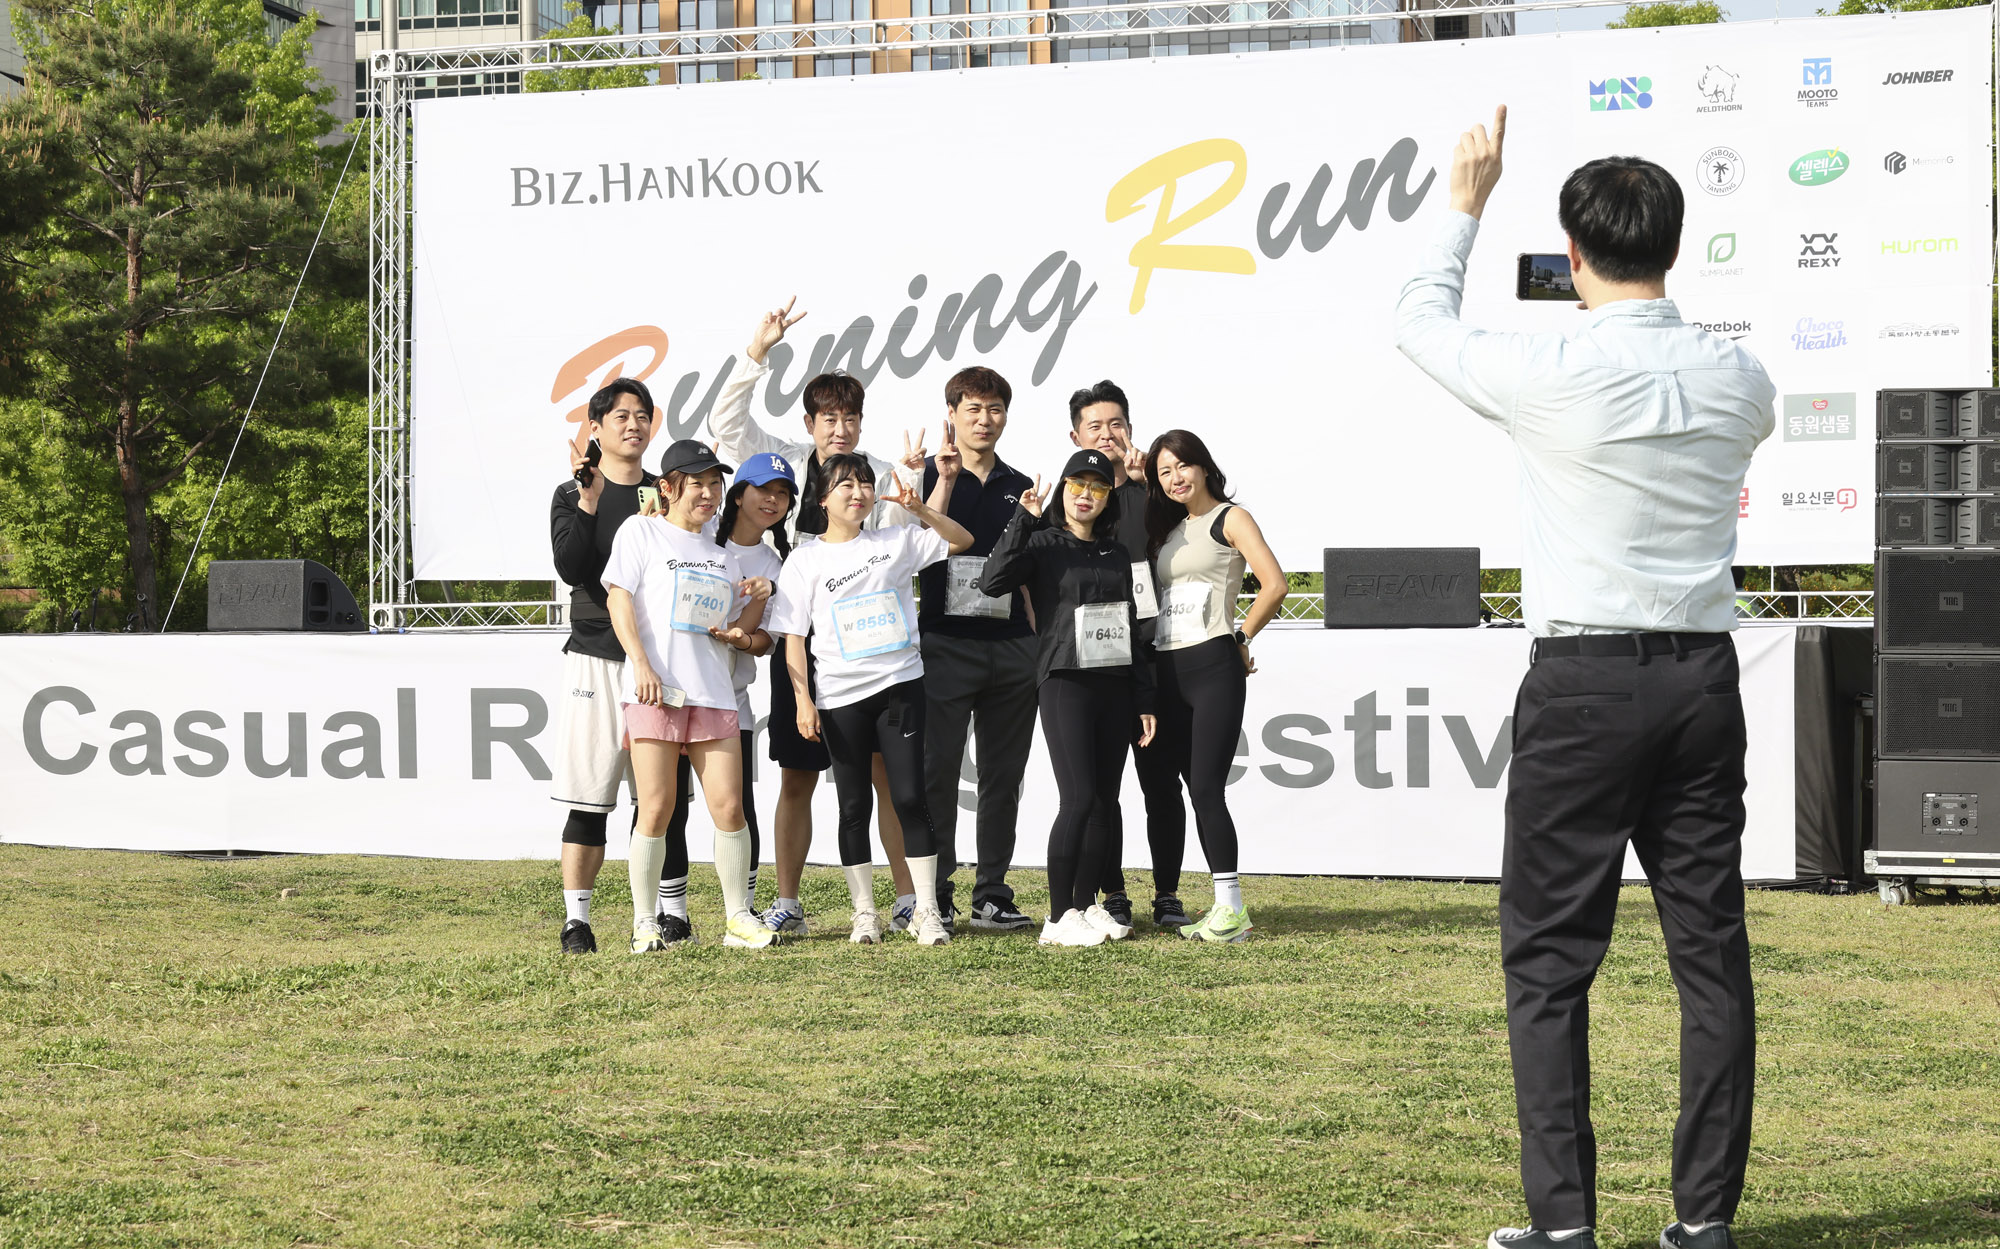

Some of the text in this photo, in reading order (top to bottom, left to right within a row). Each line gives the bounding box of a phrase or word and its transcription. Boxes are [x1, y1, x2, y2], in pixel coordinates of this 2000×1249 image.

[1882, 69, 1954, 85] JOHNBER
[1797, 89, 1838, 99] MOOTO
[1702, 149, 1739, 165] SUNBODY
[1795, 156, 1845, 181] 셀렉스
[1706, 182, 1737, 194] TANNING
[1105, 137, 1436, 315] Run
[1798, 257, 1842, 268] REXY
[1795, 316, 1844, 333] Choco
[1791, 330, 1848, 351] Health
[1788, 414, 1851, 436] 동원샘물
[770, 455, 786, 473] LA
[1782, 491, 1836, 506] 일요신문
[666, 558, 708, 571] Burning
[826, 553, 892, 593] Burning Run
[682, 593, 725, 613] M 7401
[1166, 602, 1196, 618] 6430
[843, 611, 897, 632] W 8583
[1085, 626, 1125, 641] W 6432
[22, 685, 418, 780] Casual
